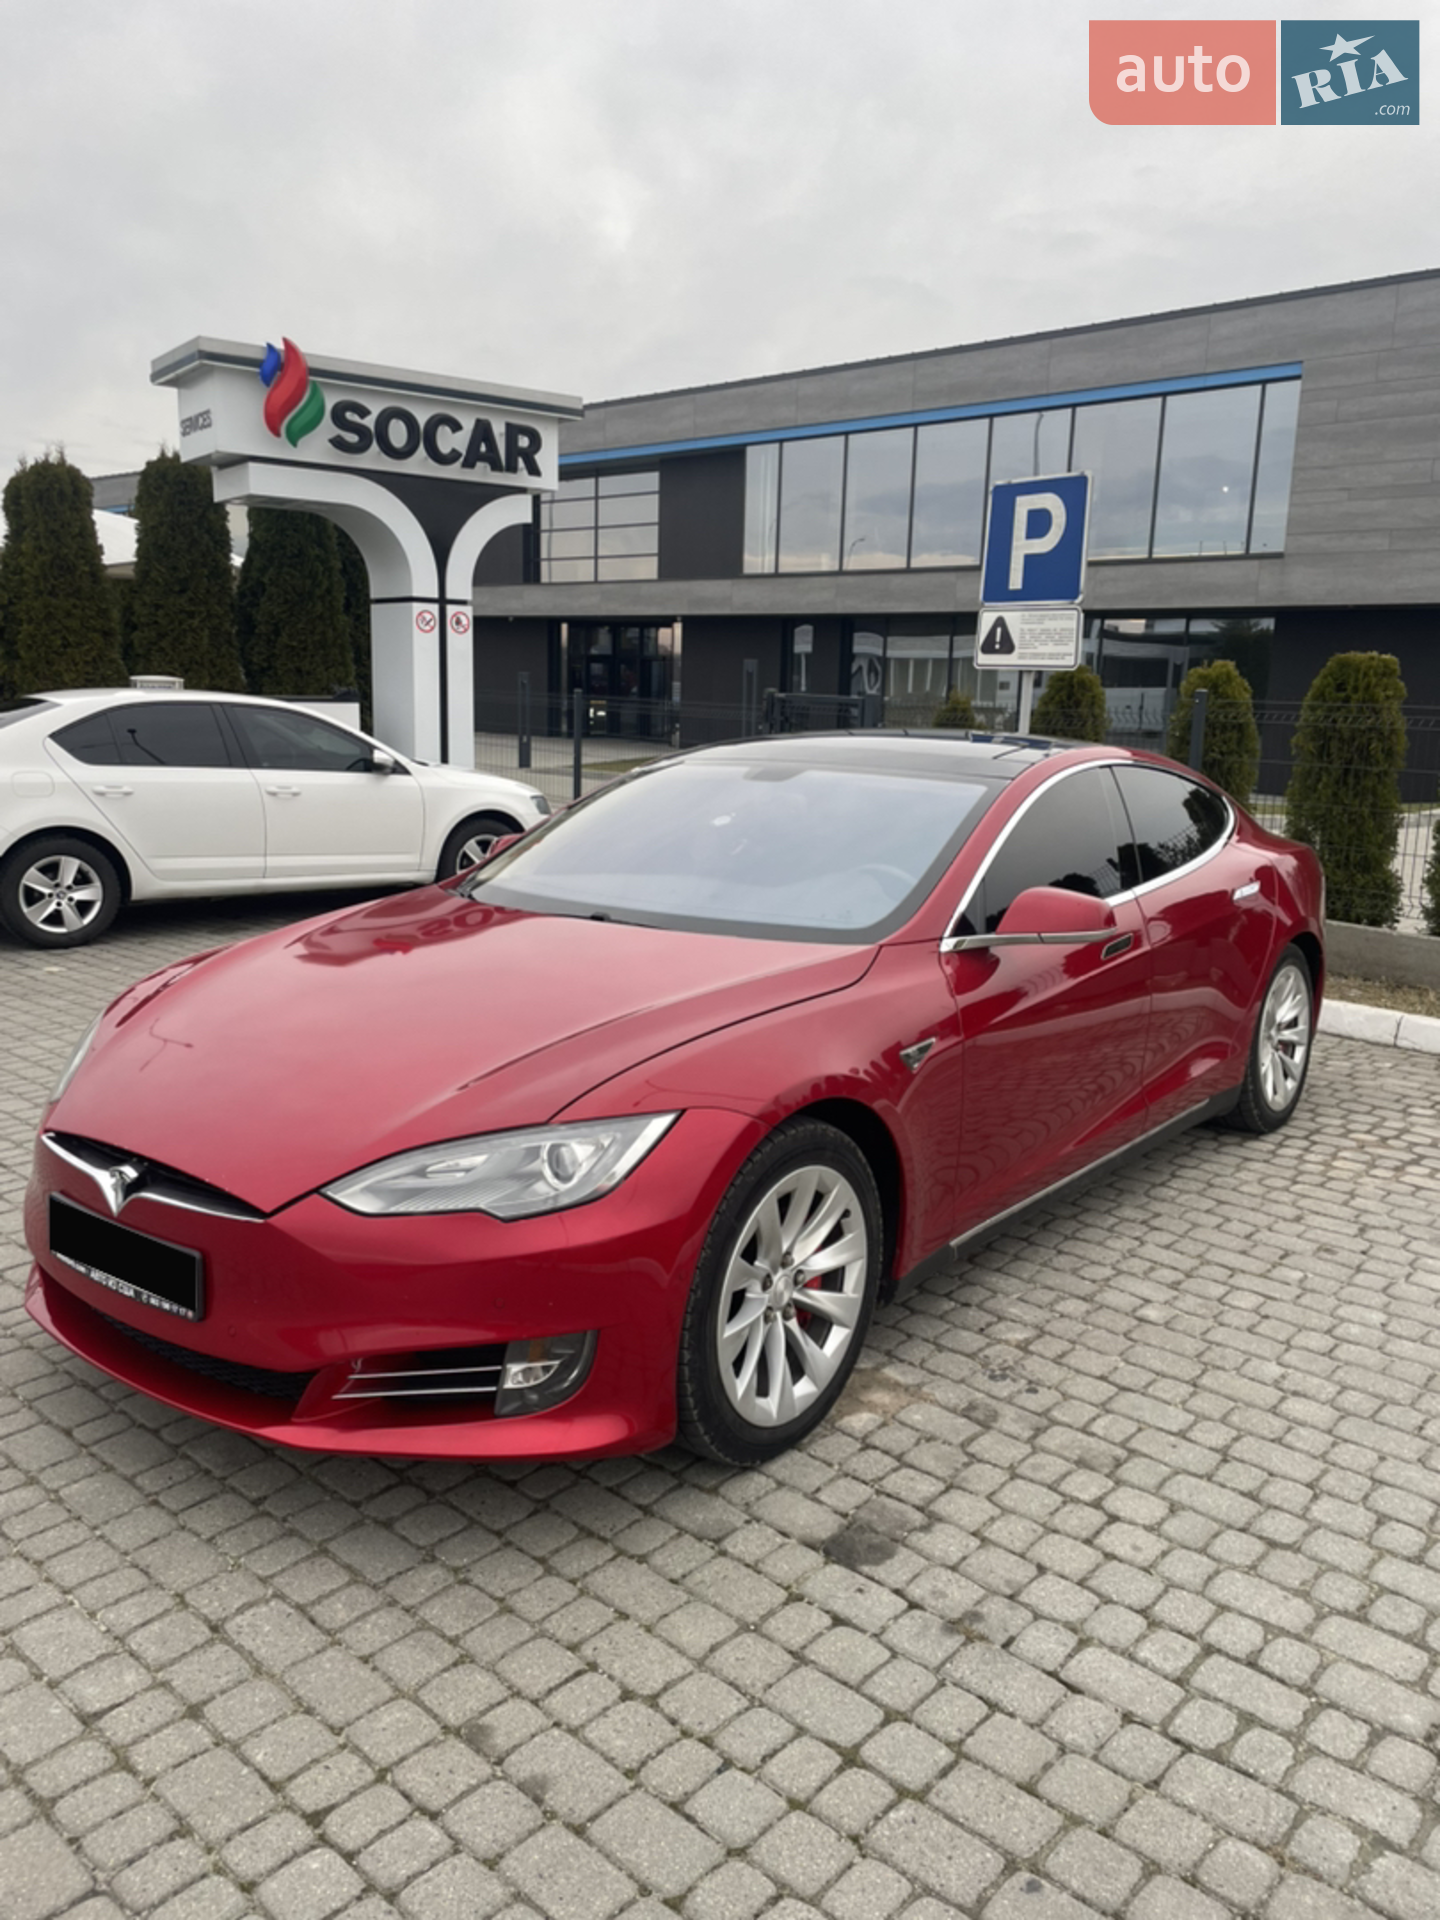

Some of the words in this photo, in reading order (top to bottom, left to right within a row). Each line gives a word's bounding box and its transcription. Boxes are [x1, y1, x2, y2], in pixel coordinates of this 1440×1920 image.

[180, 408, 212, 438] SERVICES
[328, 399, 542, 477] SOCAR
[1008, 492, 1067, 591] P
